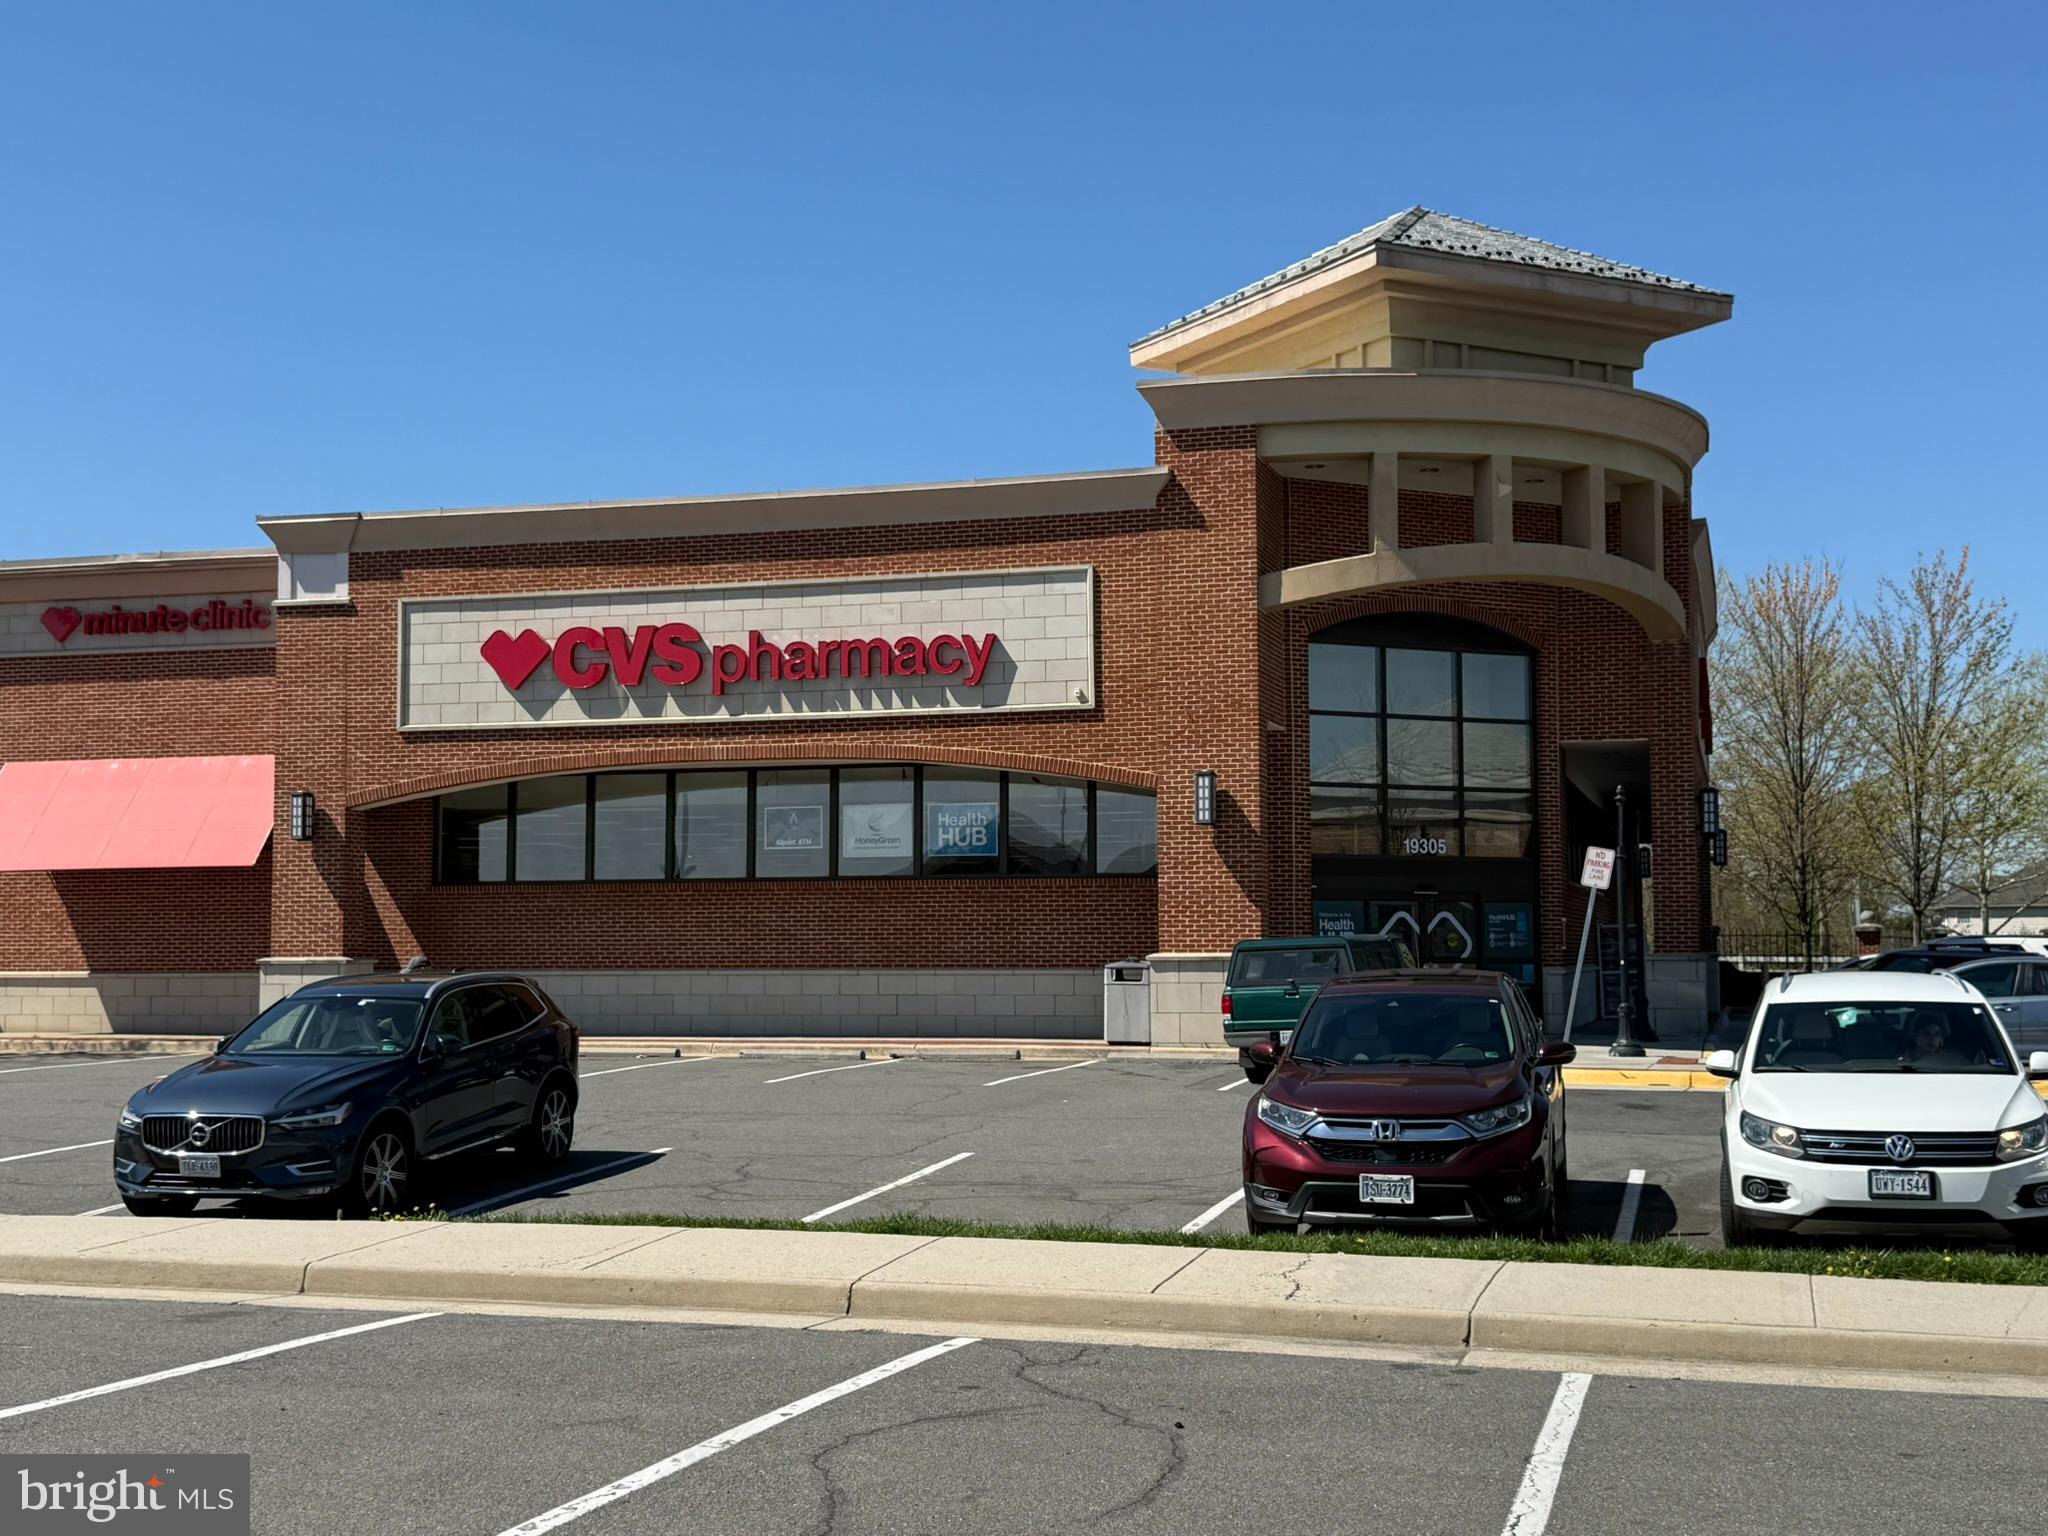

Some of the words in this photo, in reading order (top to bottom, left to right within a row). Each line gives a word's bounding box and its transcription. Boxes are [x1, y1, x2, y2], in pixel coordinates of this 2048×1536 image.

[552, 622, 704, 690] CVS
[711, 630, 998, 696] pharmacy
[938, 812, 987, 826] Health
[855, 837, 901, 845] MoneyGram
[938, 827, 988, 846] HUB
[1403, 838, 1447, 854] 19305
[1595, 851, 1606, 860] NO
[1319, 918, 1354, 930] Health
[1875, 1177, 1928, 1192] UWY-1544
